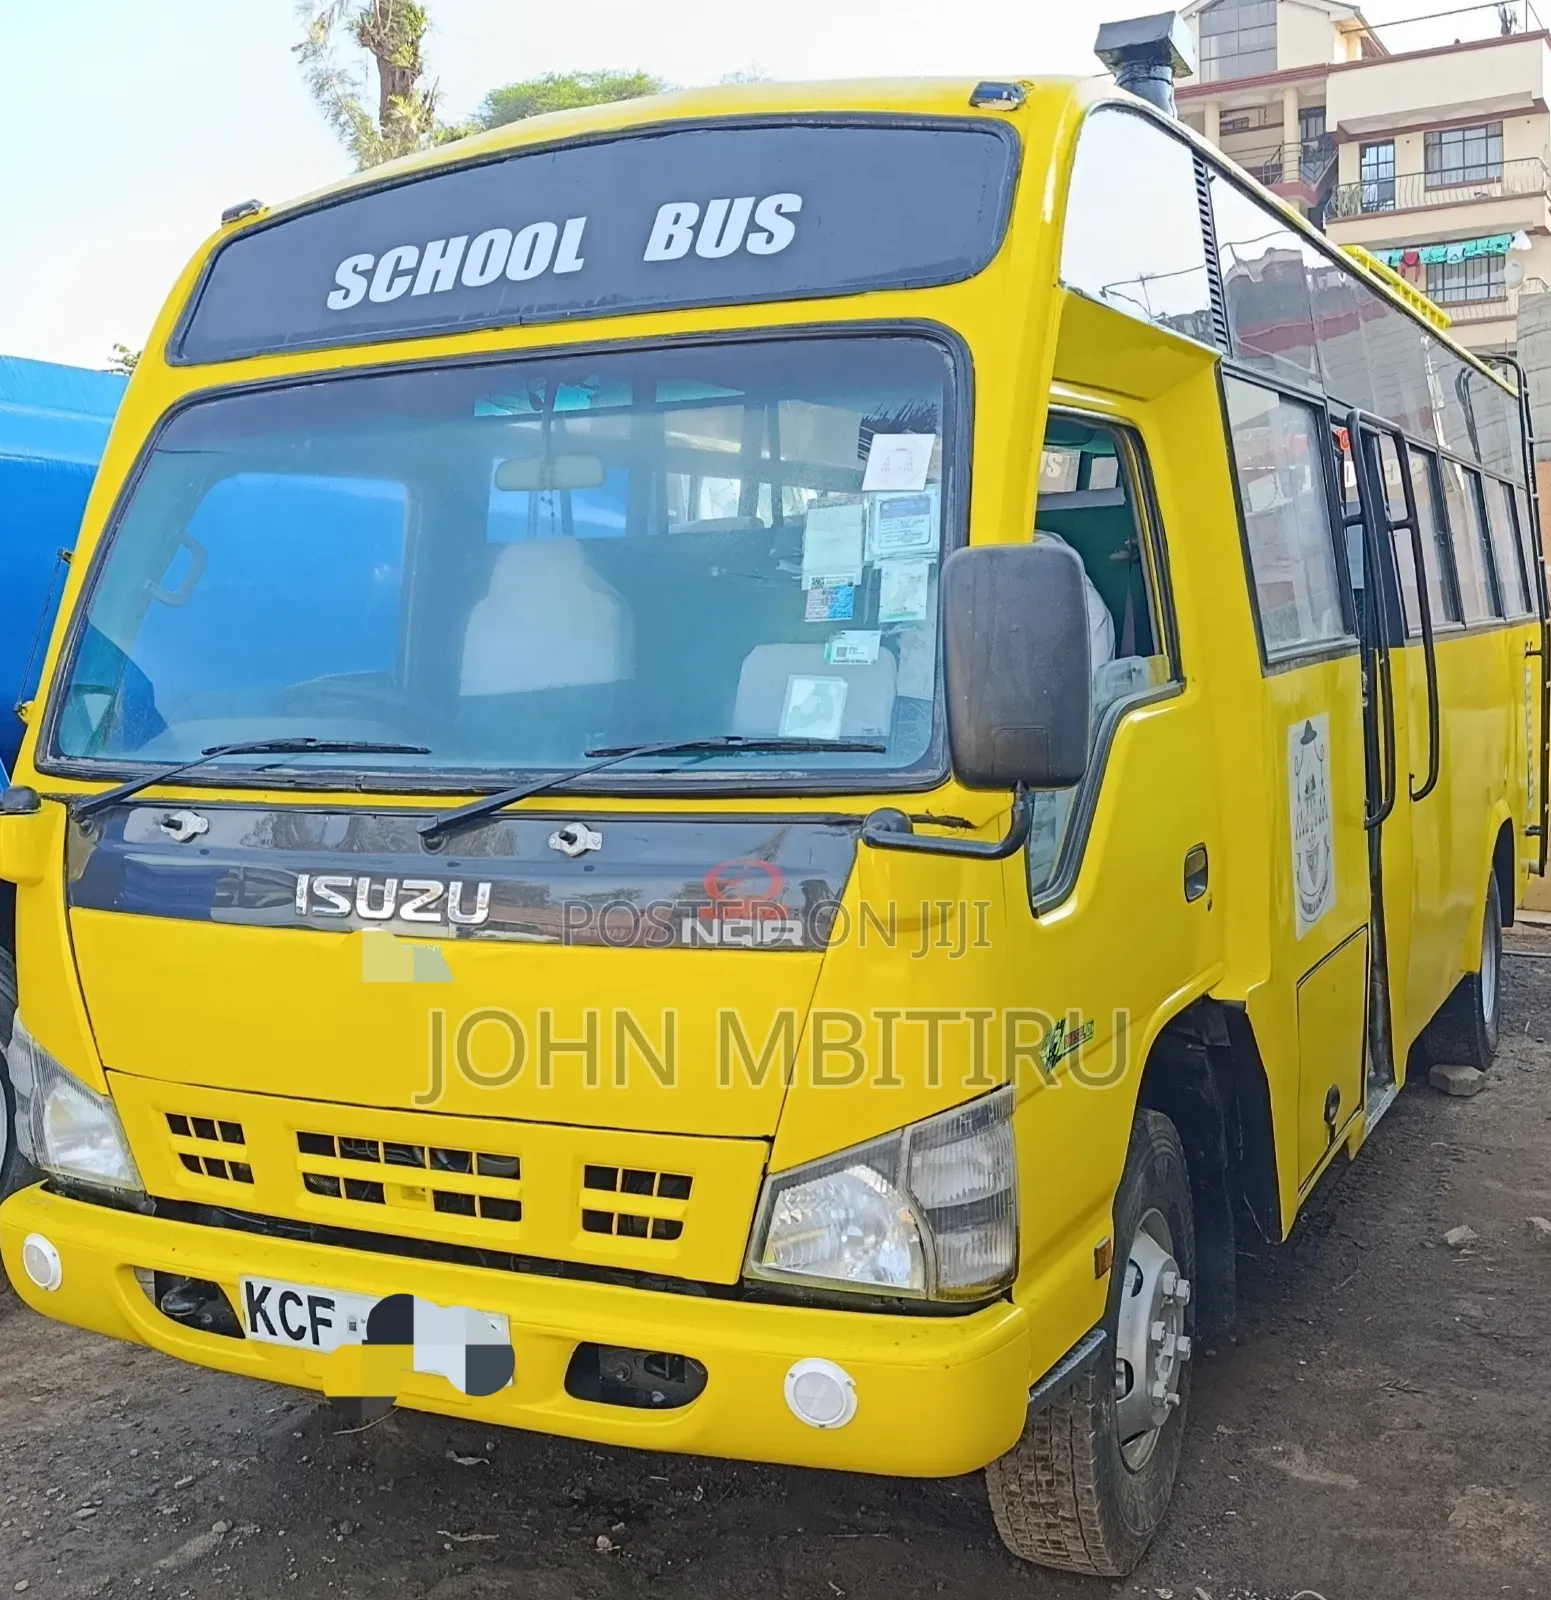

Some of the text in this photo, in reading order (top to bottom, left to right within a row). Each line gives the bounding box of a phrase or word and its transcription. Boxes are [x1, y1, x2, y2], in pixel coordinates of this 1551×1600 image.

[326, 193, 803, 310] SCHOOL BUS
[295, 873, 493, 926] ISUZU
[245, 1280, 336, 1346] KCF
